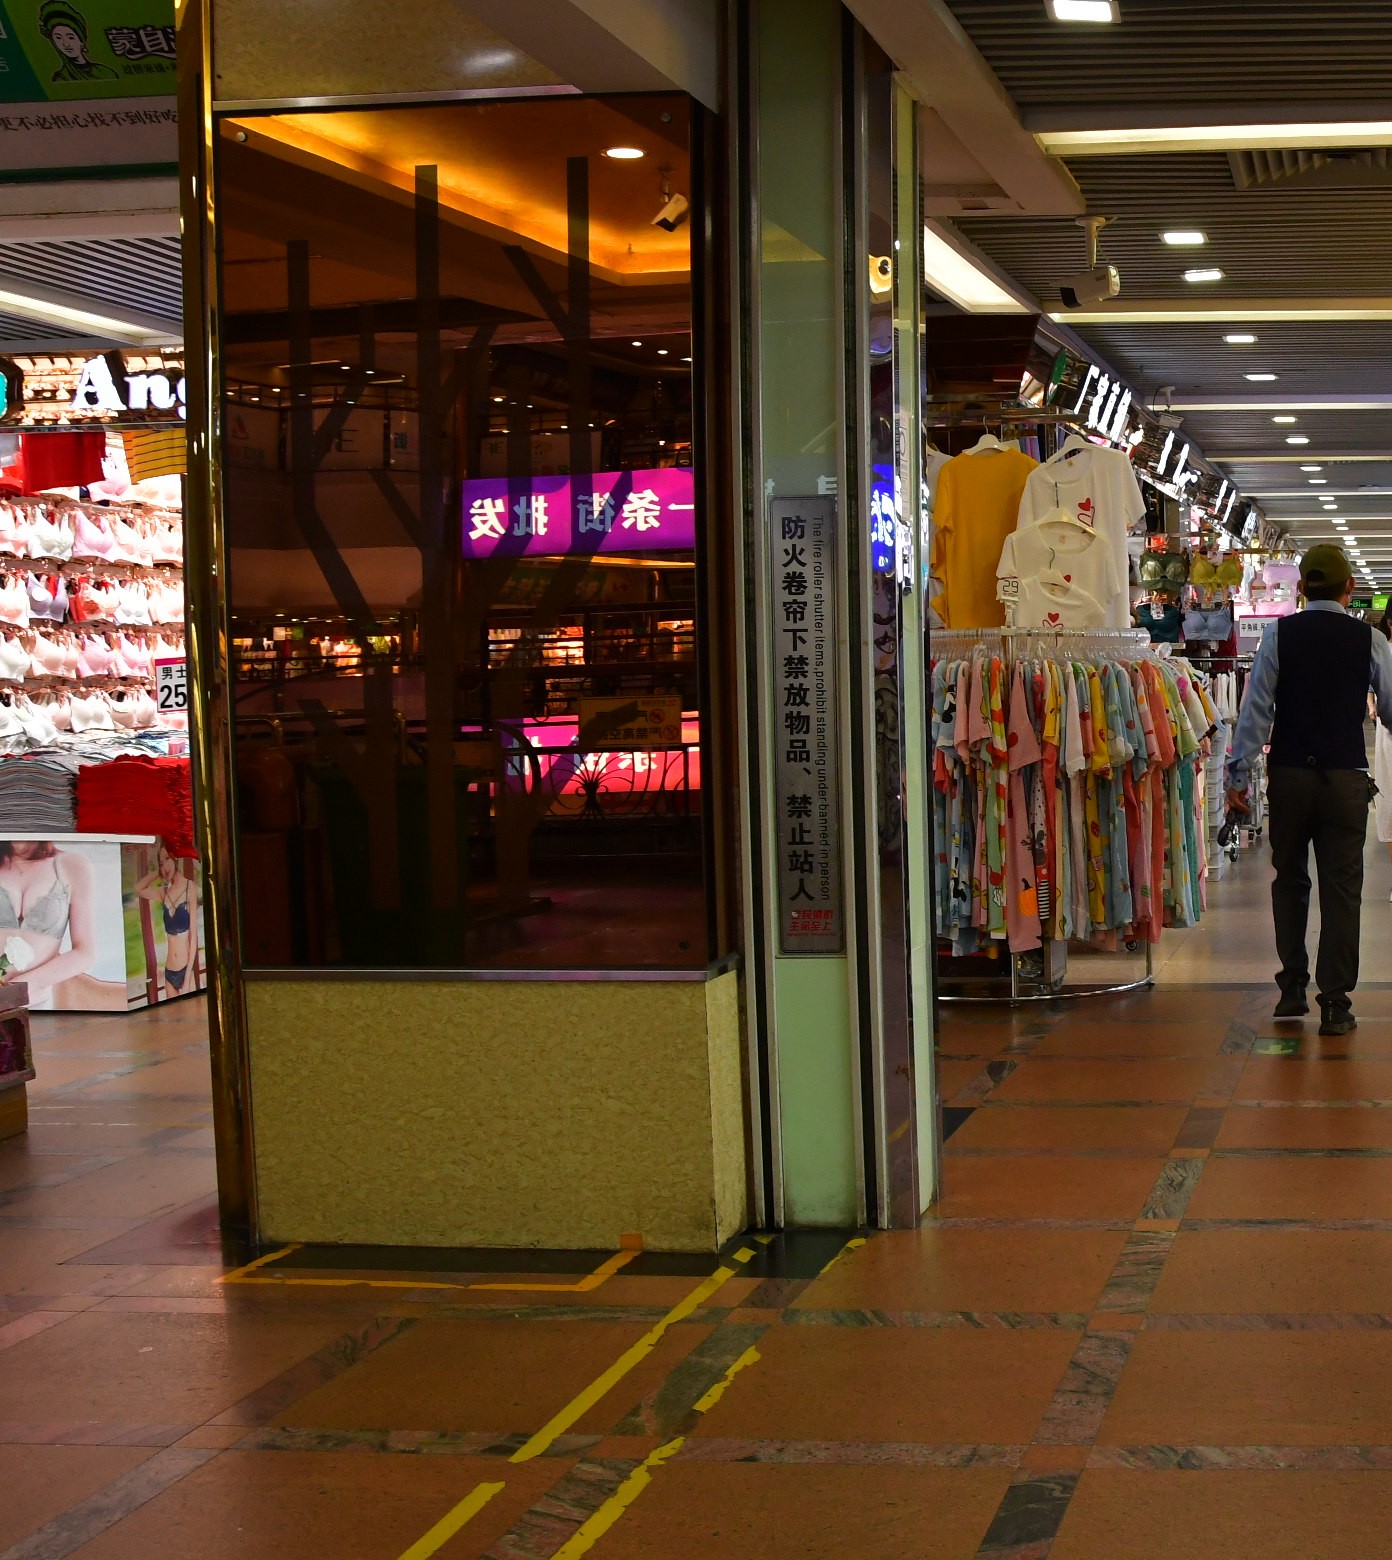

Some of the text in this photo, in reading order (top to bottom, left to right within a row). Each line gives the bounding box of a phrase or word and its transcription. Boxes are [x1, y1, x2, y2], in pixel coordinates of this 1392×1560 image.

[812, 514, 825, 537] The
[812, 538, 825, 560] fire
[814, 561, 825, 591] roller
[1002, 579, 1019, 593] 29
[814, 593, 825, 633] shutter
[161, 665, 187, 681] 男士
[159, 684, 188, 709] 25
[781, 515, 816, 902] 防火卷帘下禁放物品、禁止站人
[815, 716, 829, 768] standing
[817, 769, 829, 802] under
[817, 803, 831, 847] banned
[818, 849, 830, 866] in
[817, 867, 830, 900] person
